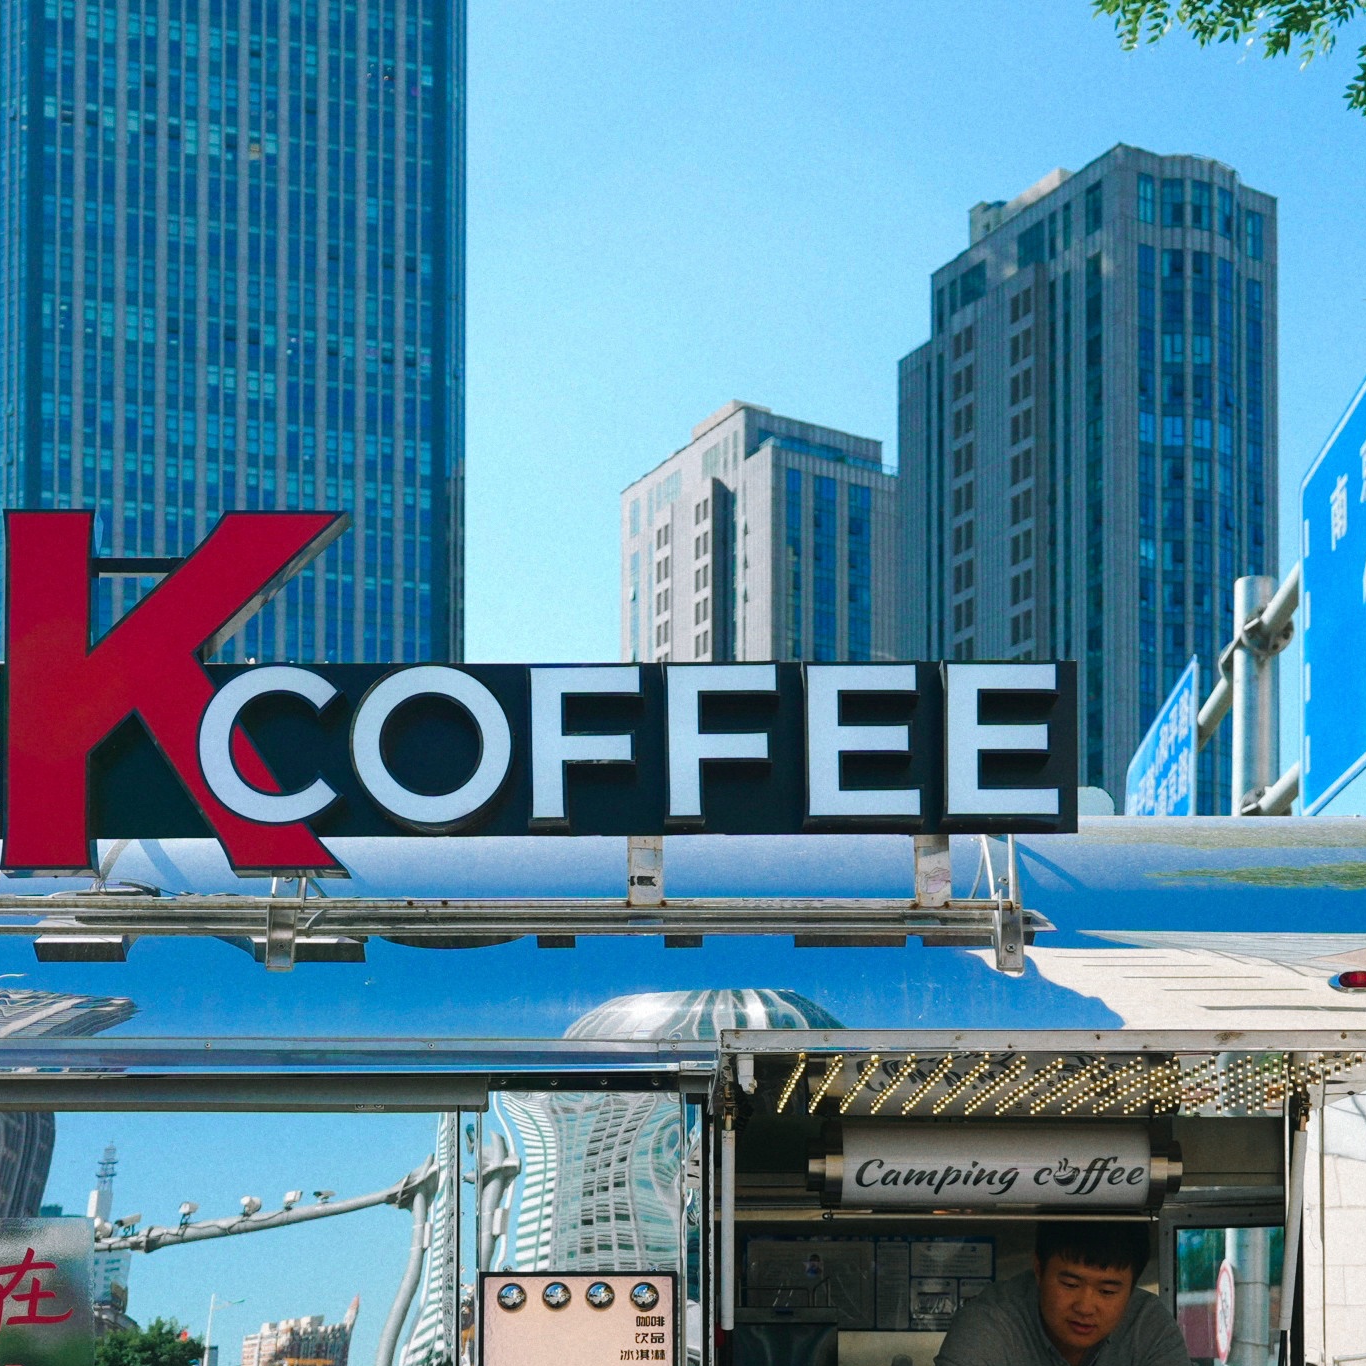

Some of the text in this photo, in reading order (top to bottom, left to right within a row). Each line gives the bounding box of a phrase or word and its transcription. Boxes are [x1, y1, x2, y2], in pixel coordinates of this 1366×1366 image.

[197, 662, 1061, 823] COFFEE
[855, 1158, 1018, 1194] Camping
[635, 1315, 666, 1327] 咖啡
[635, 1332, 665, 1344] 饮品
[620, 1349, 666, 1361] 冰淇淋
